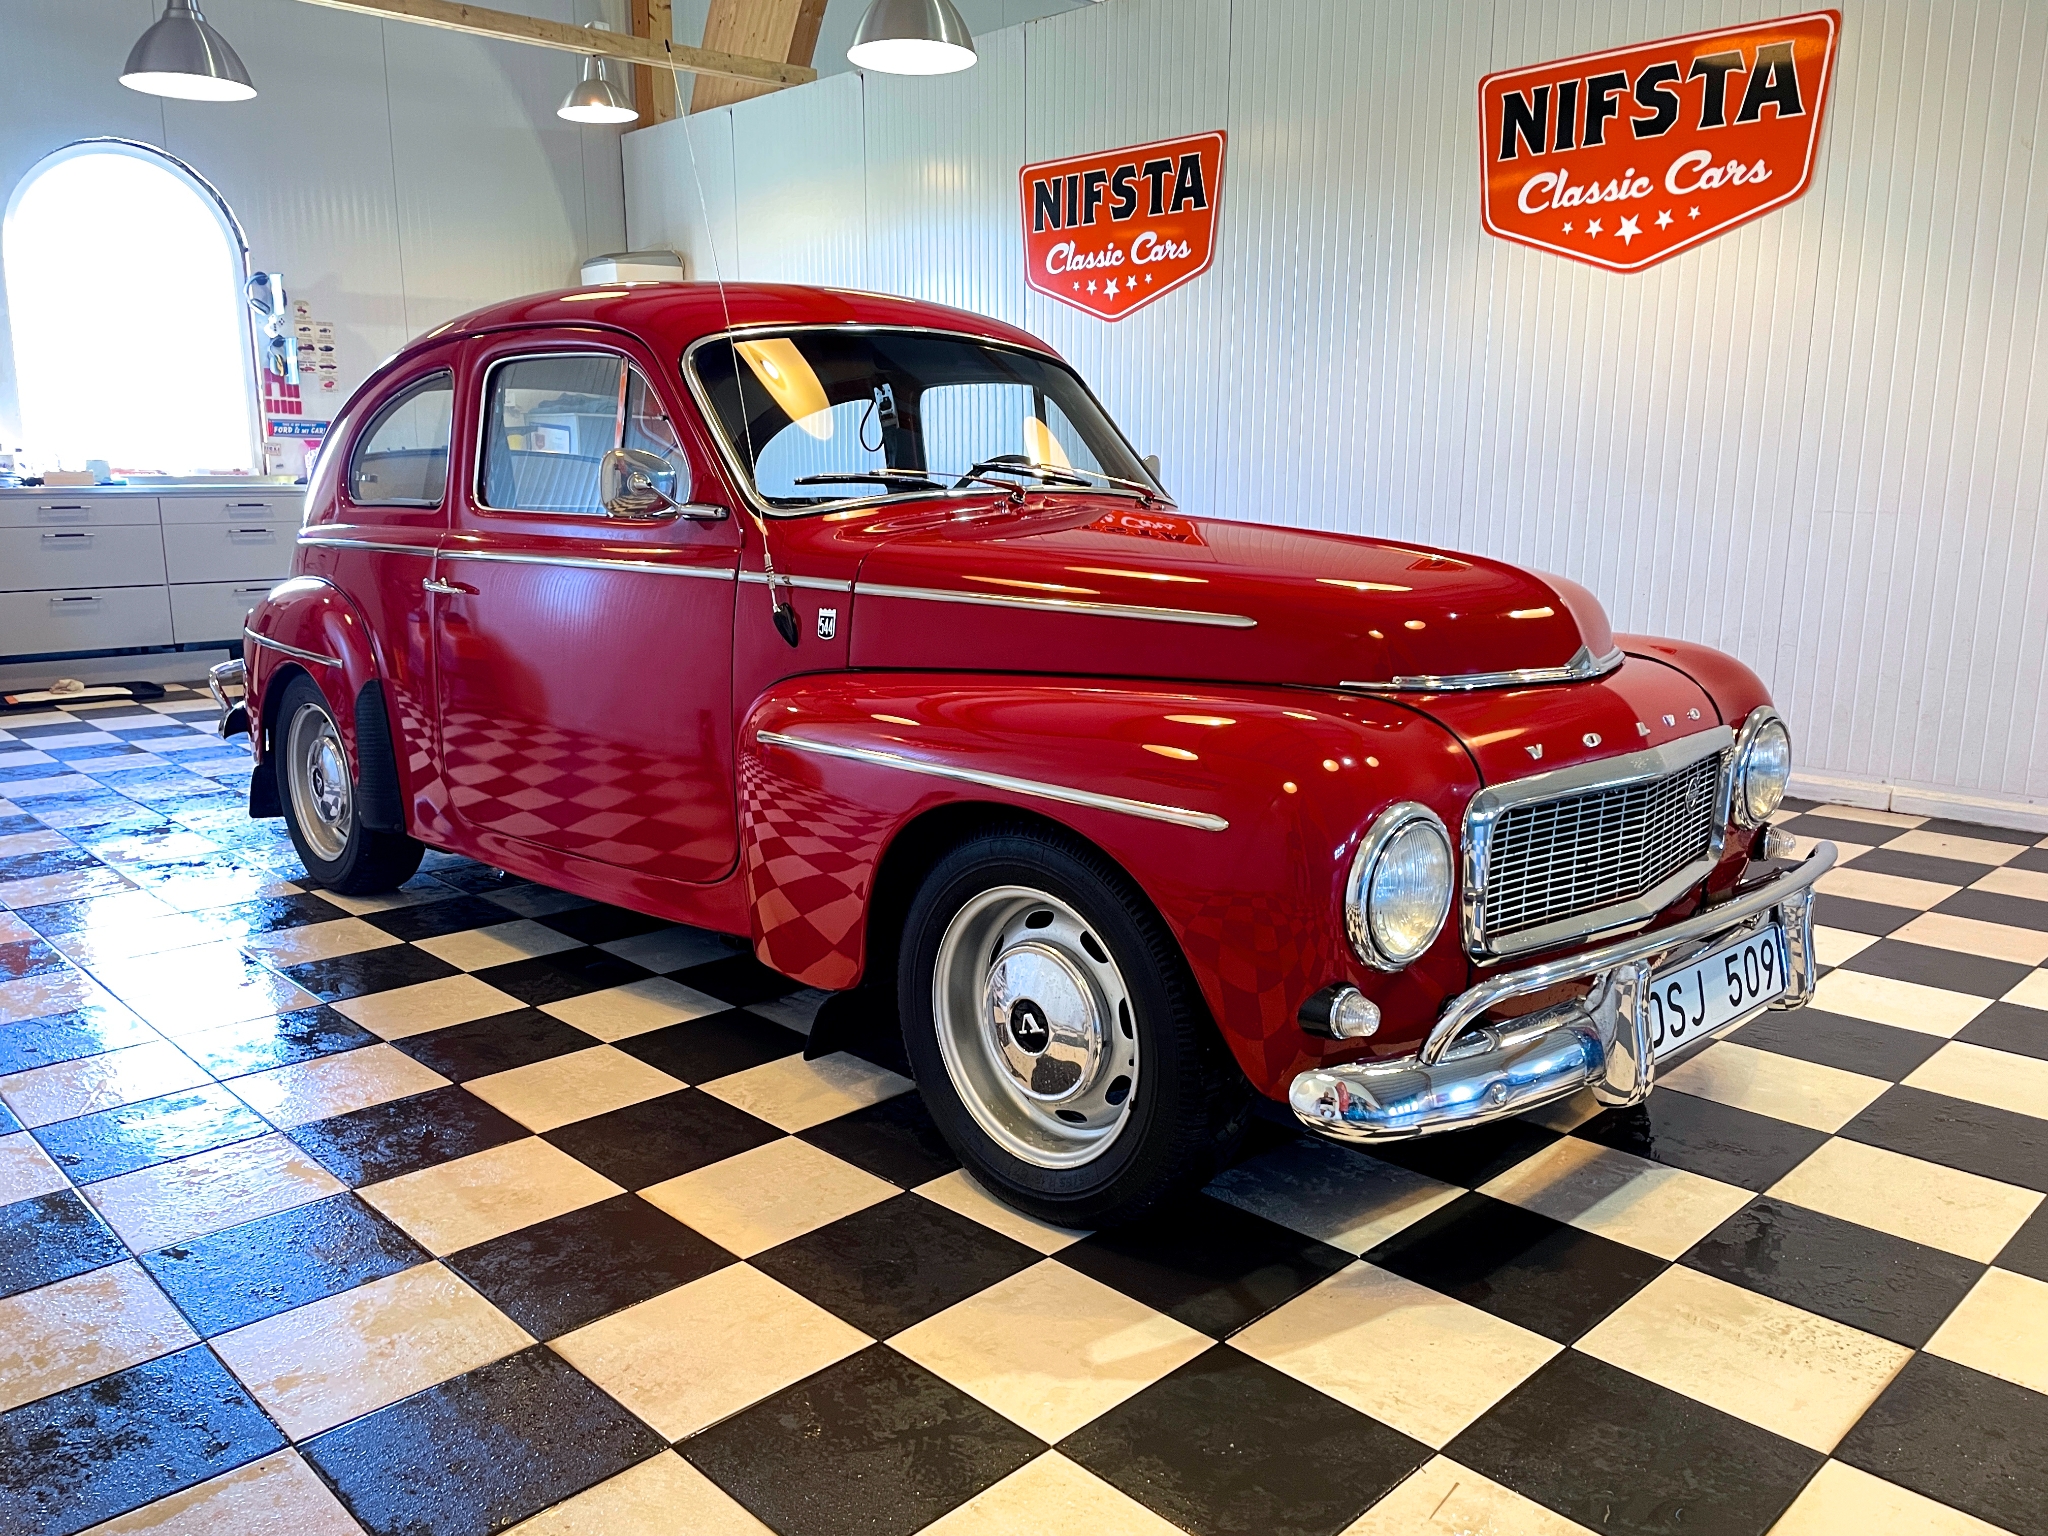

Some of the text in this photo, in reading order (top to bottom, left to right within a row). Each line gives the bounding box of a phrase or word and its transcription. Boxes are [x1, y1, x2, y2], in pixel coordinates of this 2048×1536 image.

[1497, 40, 1806, 162] NIFSTA
[1033, 152, 1208, 233] NIFSTA
[1517, 149, 1773, 215] Classic Cars
[1046, 231, 1191, 274] Classic Cars
[274, 426, 293, 434] FORD
[819, 617, 834, 636] 544
[1524, 707, 1701, 761] VOLVO
[1724, 938, 1774, 1007] 509
